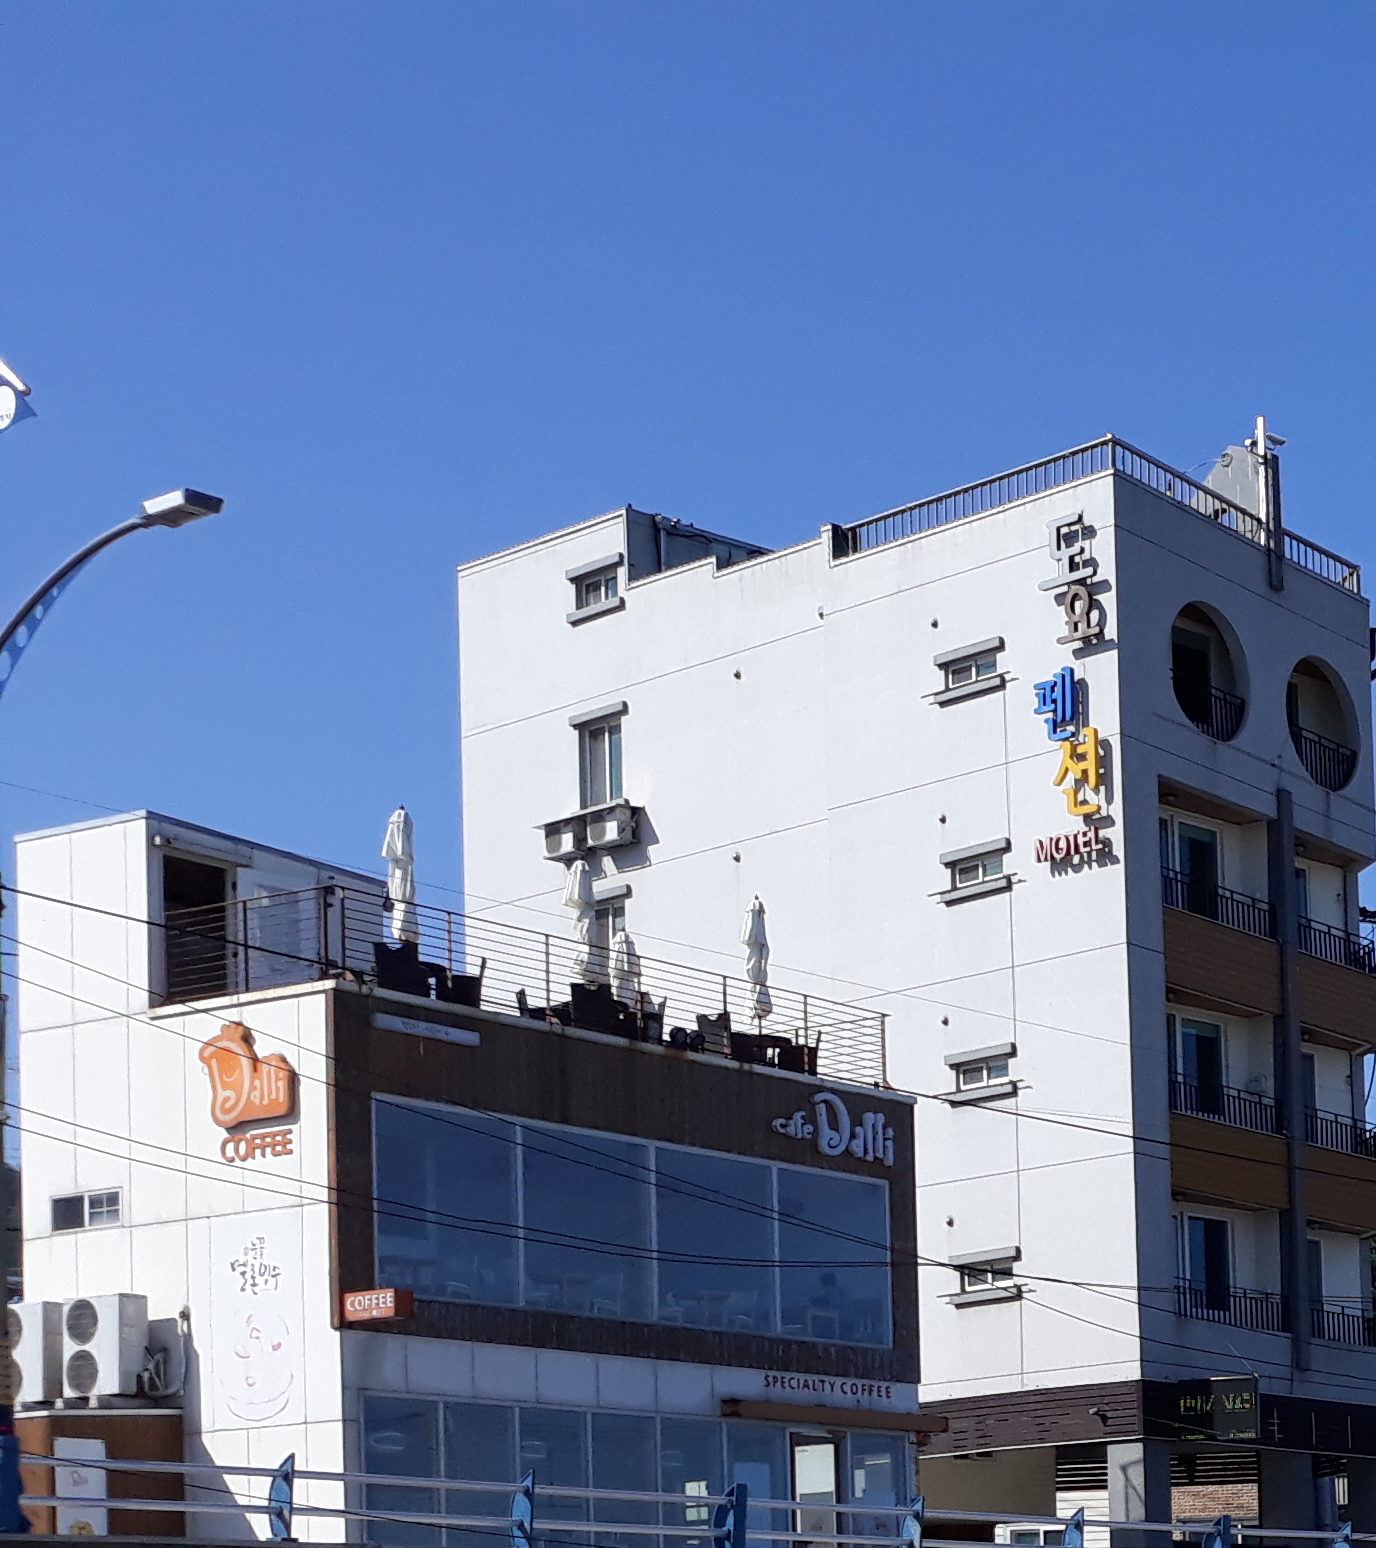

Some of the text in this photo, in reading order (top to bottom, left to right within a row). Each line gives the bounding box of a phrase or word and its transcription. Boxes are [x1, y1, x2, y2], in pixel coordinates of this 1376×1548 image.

[1034, 511, 1102, 816] 도요 펜션
[1034, 825, 1104, 863] MOTEL
[202, 1040, 286, 1121] Dalli
[220, 1128, 293, 1163] COFFEE
[771, 1092, 895, 1167] cafe Dalli
[346, 1292, 395, 1311] COFFEE
[764, 1374, 893, 1399] SPECIALTY COFFEE
